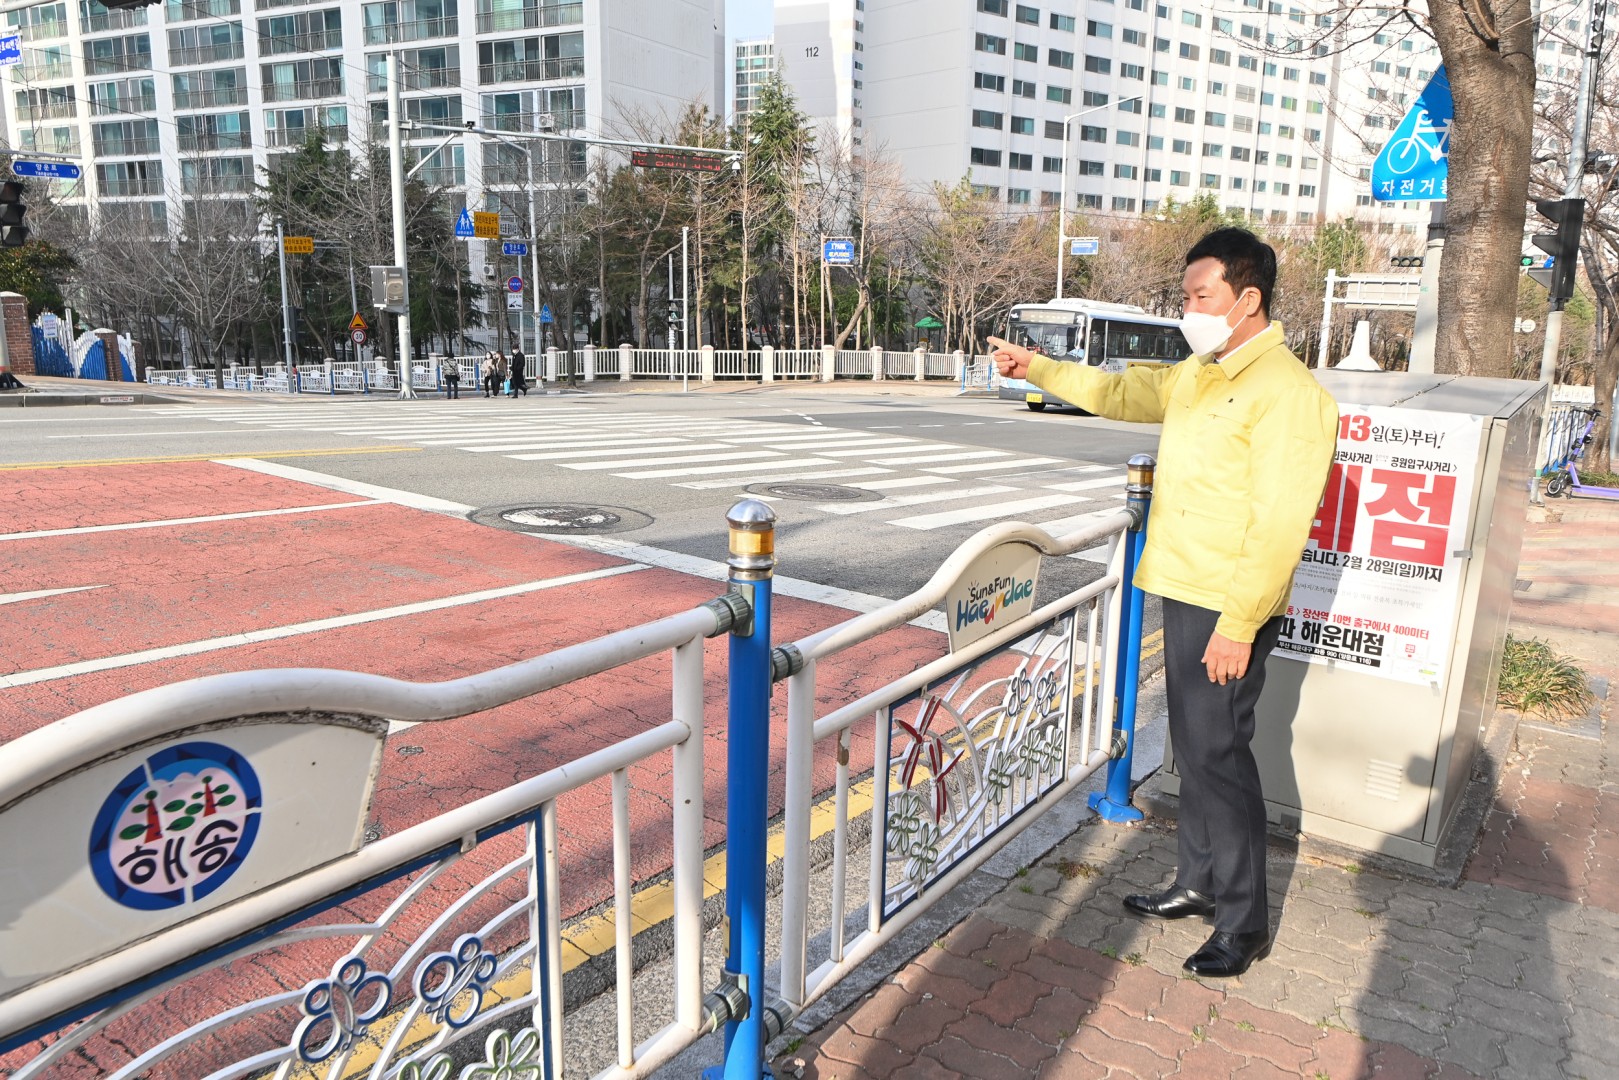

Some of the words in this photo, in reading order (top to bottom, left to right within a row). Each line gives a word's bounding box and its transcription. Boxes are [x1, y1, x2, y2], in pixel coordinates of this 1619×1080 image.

[805, 46, 819, 58] 112
[35, 163, 57, 172] 양운로
[1390, 457, 1451, 473] 공원입구사거리
[1342, 554, 1363, 571] 2월
[1366, 558, 1443, 583] 28일(일)까지
[956, 576, 1033, 632] Haeundae
[969, 576, 1011, 604] Sun&Fun
[1302, 607, 1330, 622] 장산역
[1332, 613, 1352, 626] 10번
[1354, 617, 1391, 633] 출구에서
[1393, 624, 1429, 640] 400미터
[1278, 641, 1290, 649] 부산
[1291, 644, 1313, 653] 해운대구
[1314, 648, 1326, 657] 좌동
[1326, 650, 1338, 658] 990
[1301, 620, 1385, 657] 해운대점
[118, 819, 239, 885] 해송
